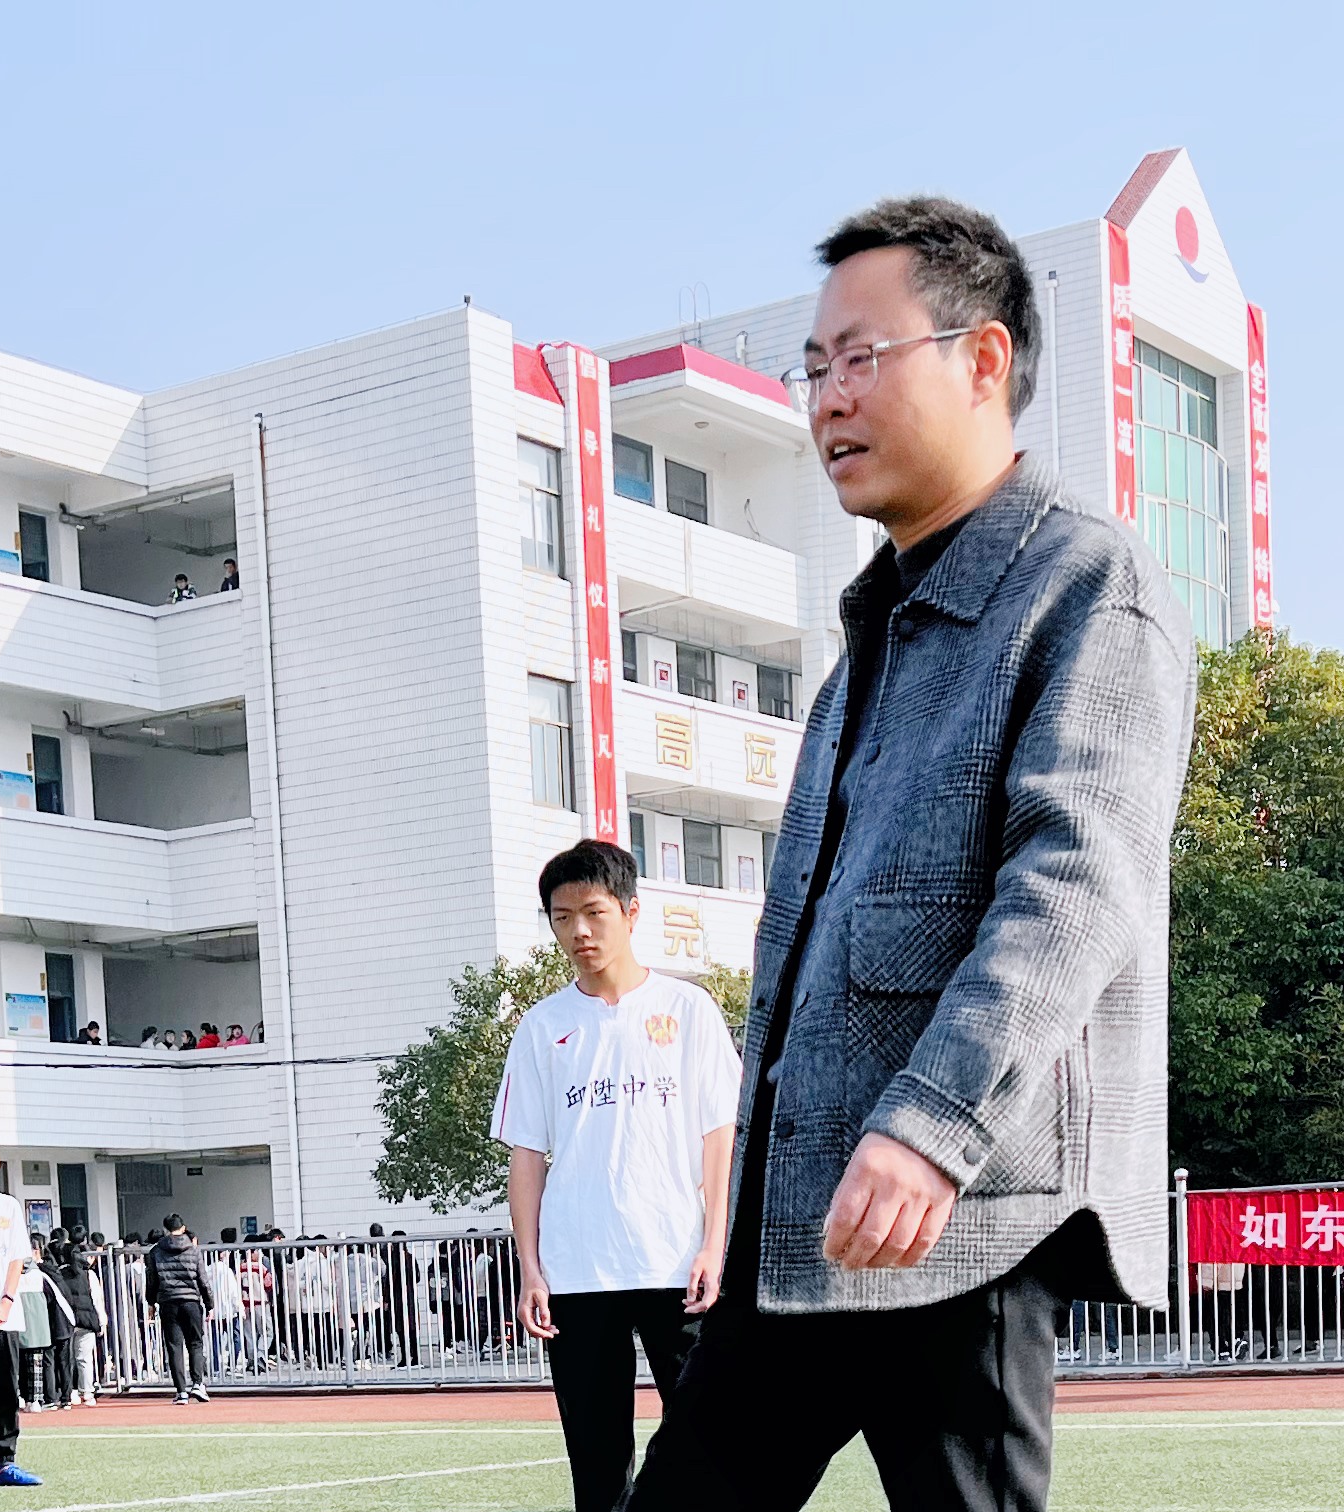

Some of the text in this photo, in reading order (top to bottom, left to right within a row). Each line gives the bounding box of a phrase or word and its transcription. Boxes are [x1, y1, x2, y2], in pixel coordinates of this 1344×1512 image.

[655, 711, 779, 787] 高远
[565, 1074, 677, 1108] 邱陞中学
